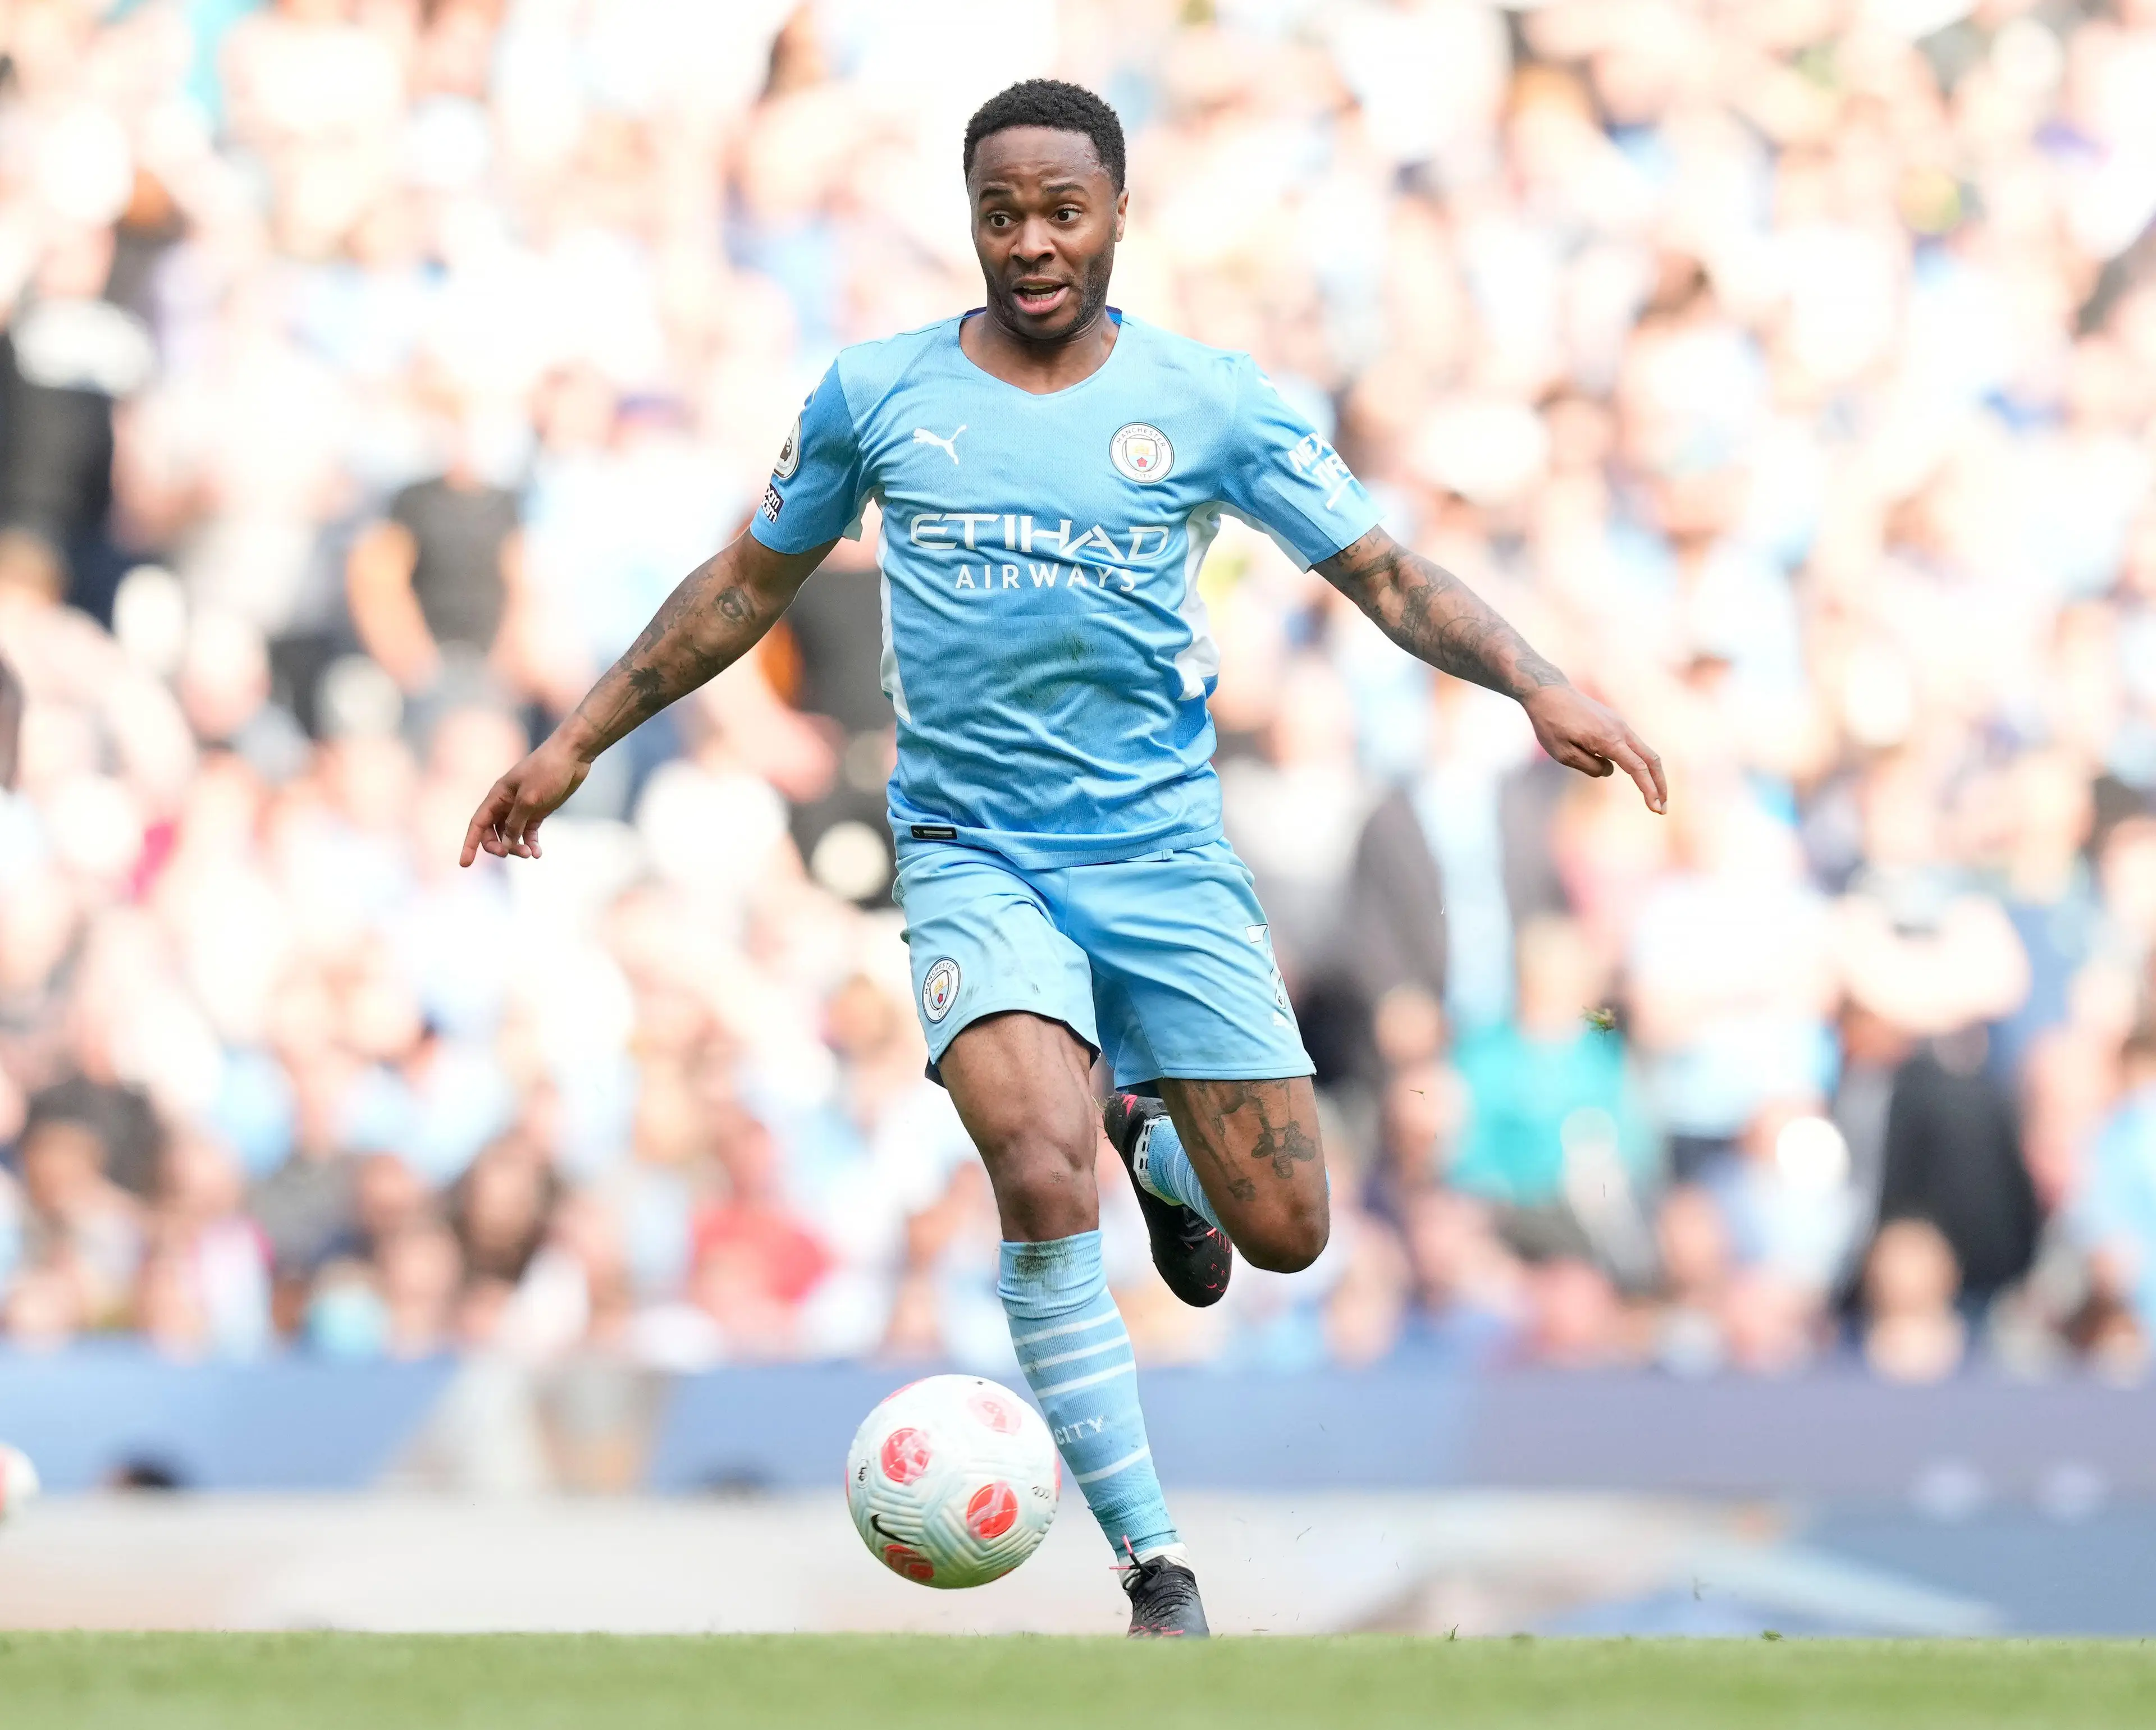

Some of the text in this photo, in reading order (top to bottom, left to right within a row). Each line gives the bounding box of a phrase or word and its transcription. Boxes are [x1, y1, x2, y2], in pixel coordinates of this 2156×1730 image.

[1116, 427, 1166, 447] MANCHESTER
[1312, 452, 1350, 489] TIR
[910, 513, 1169, 561] ETIHAD
[955, 564, 1135, 592] AIRWAYS
[925, 962, 955, 995] MANCHESTER
[938, 1005, 948, 1018] CITY
[1054, 1415, 1104, 1445] CITY
